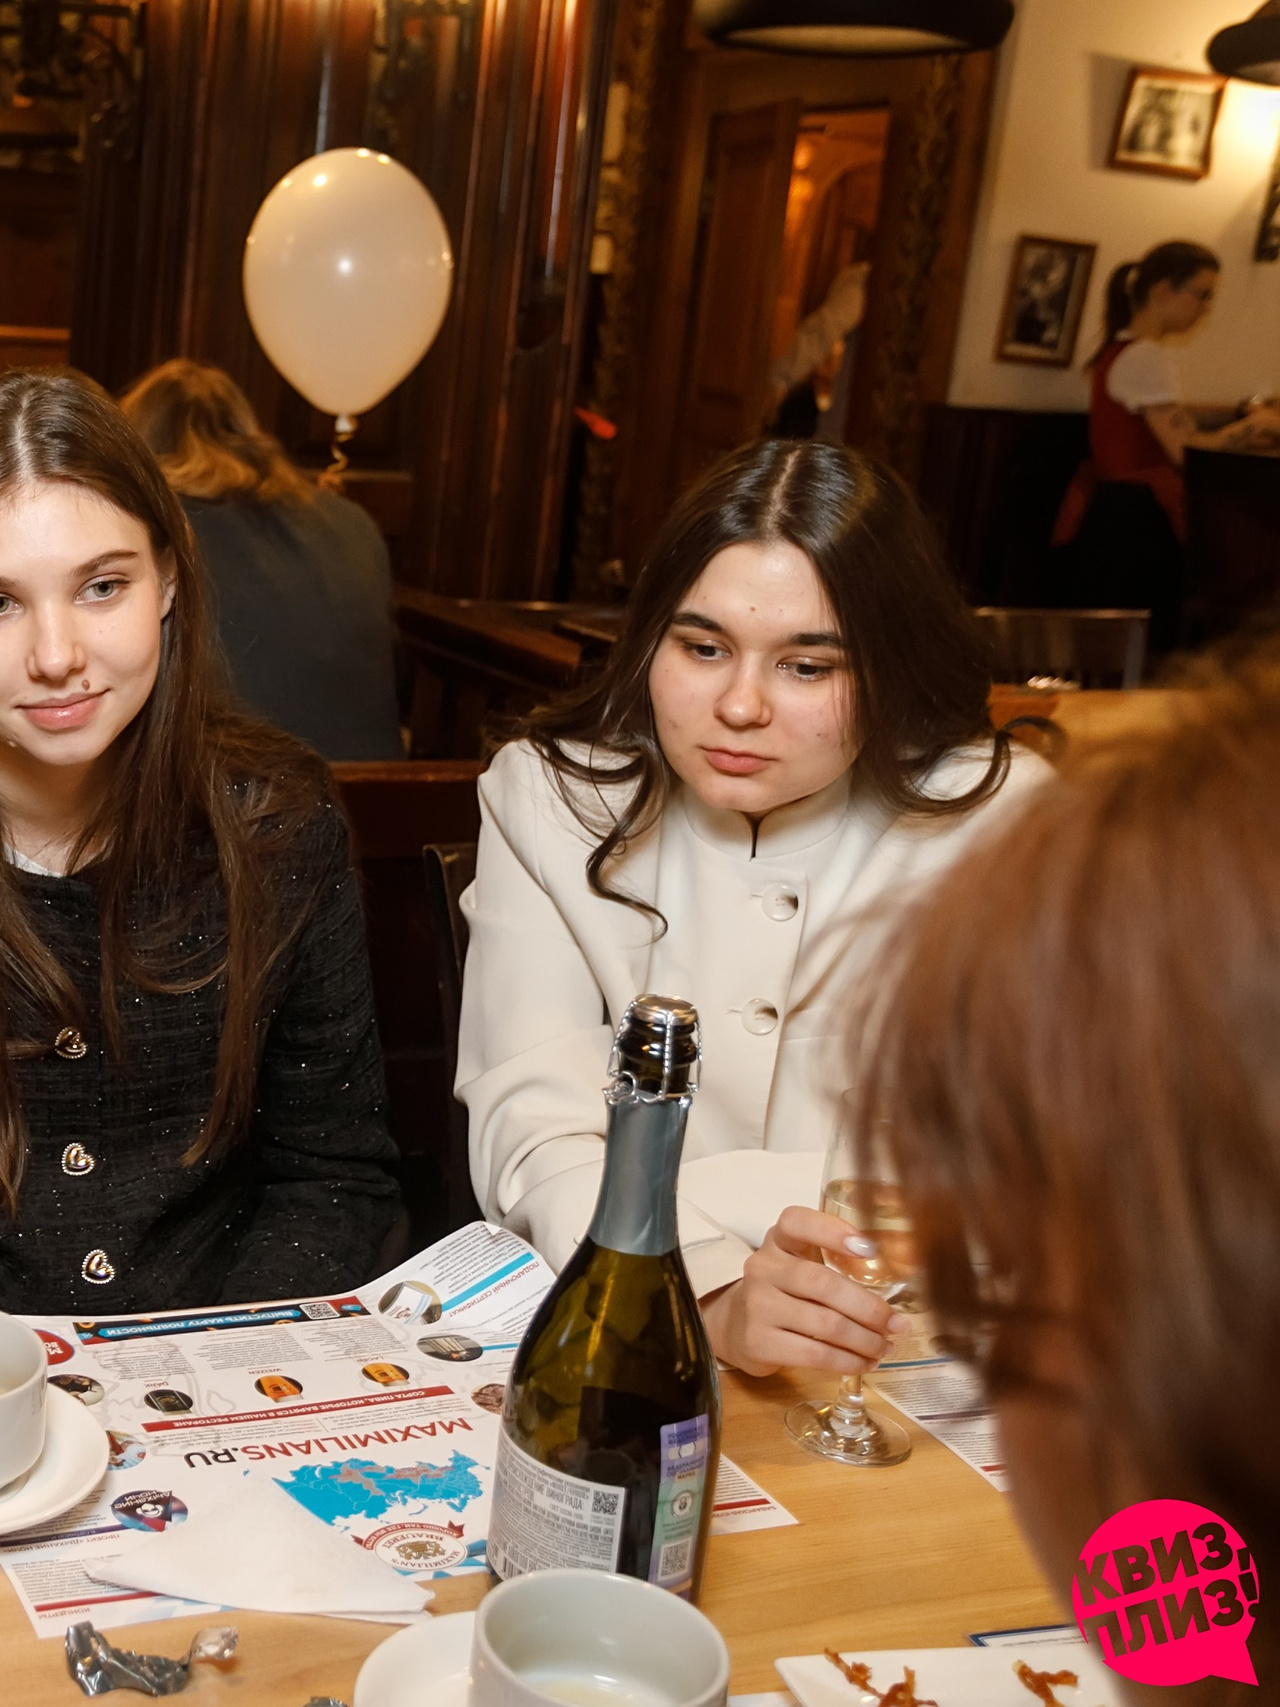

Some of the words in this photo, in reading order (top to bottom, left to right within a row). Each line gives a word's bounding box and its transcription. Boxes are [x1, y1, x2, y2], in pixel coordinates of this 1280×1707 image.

[492, 1261, 539, 1292] ПОДАРОЧНЫЙ
[448, 1289, 492, 1317] СЕРТИФИКАТ
[187, 1317, 224, 1326] КАРТУ
[224, 1310, 292, 1321] ВЫПУСТИТЬ
[107, 1322, 184, 1335] ЛОЯЛЬНОСТИ
[364, 1392, 393, 1403] ПИВА,
[392, 1389, 425, 1399] СОРТА
[319, 1398, 364, 1409] КОТОРЫЕ
[275, 1405, 318, 1415] ВАРЯТСЯ
[172, 1415, 228, 1428] РЕСТОРАНЕ
[229, 1412, 266, 1421] НАШЕМ
[183, 1416, 473, 1468] MAXIMILIANS.RU
[114, 1491, 170, 1508] ДЫХАНИЕ
[124, 1489, 156, 1501] НОЧИ
[86, 1533, 119, 1542] ПРОЕКТ
[381, 1532, 443, 1548] BRAUEREI
[390, 1550, 460, 1568] MAXIMILIAN'S
[38, 1607, 89, 1619] КОНЦЕРТЫ
